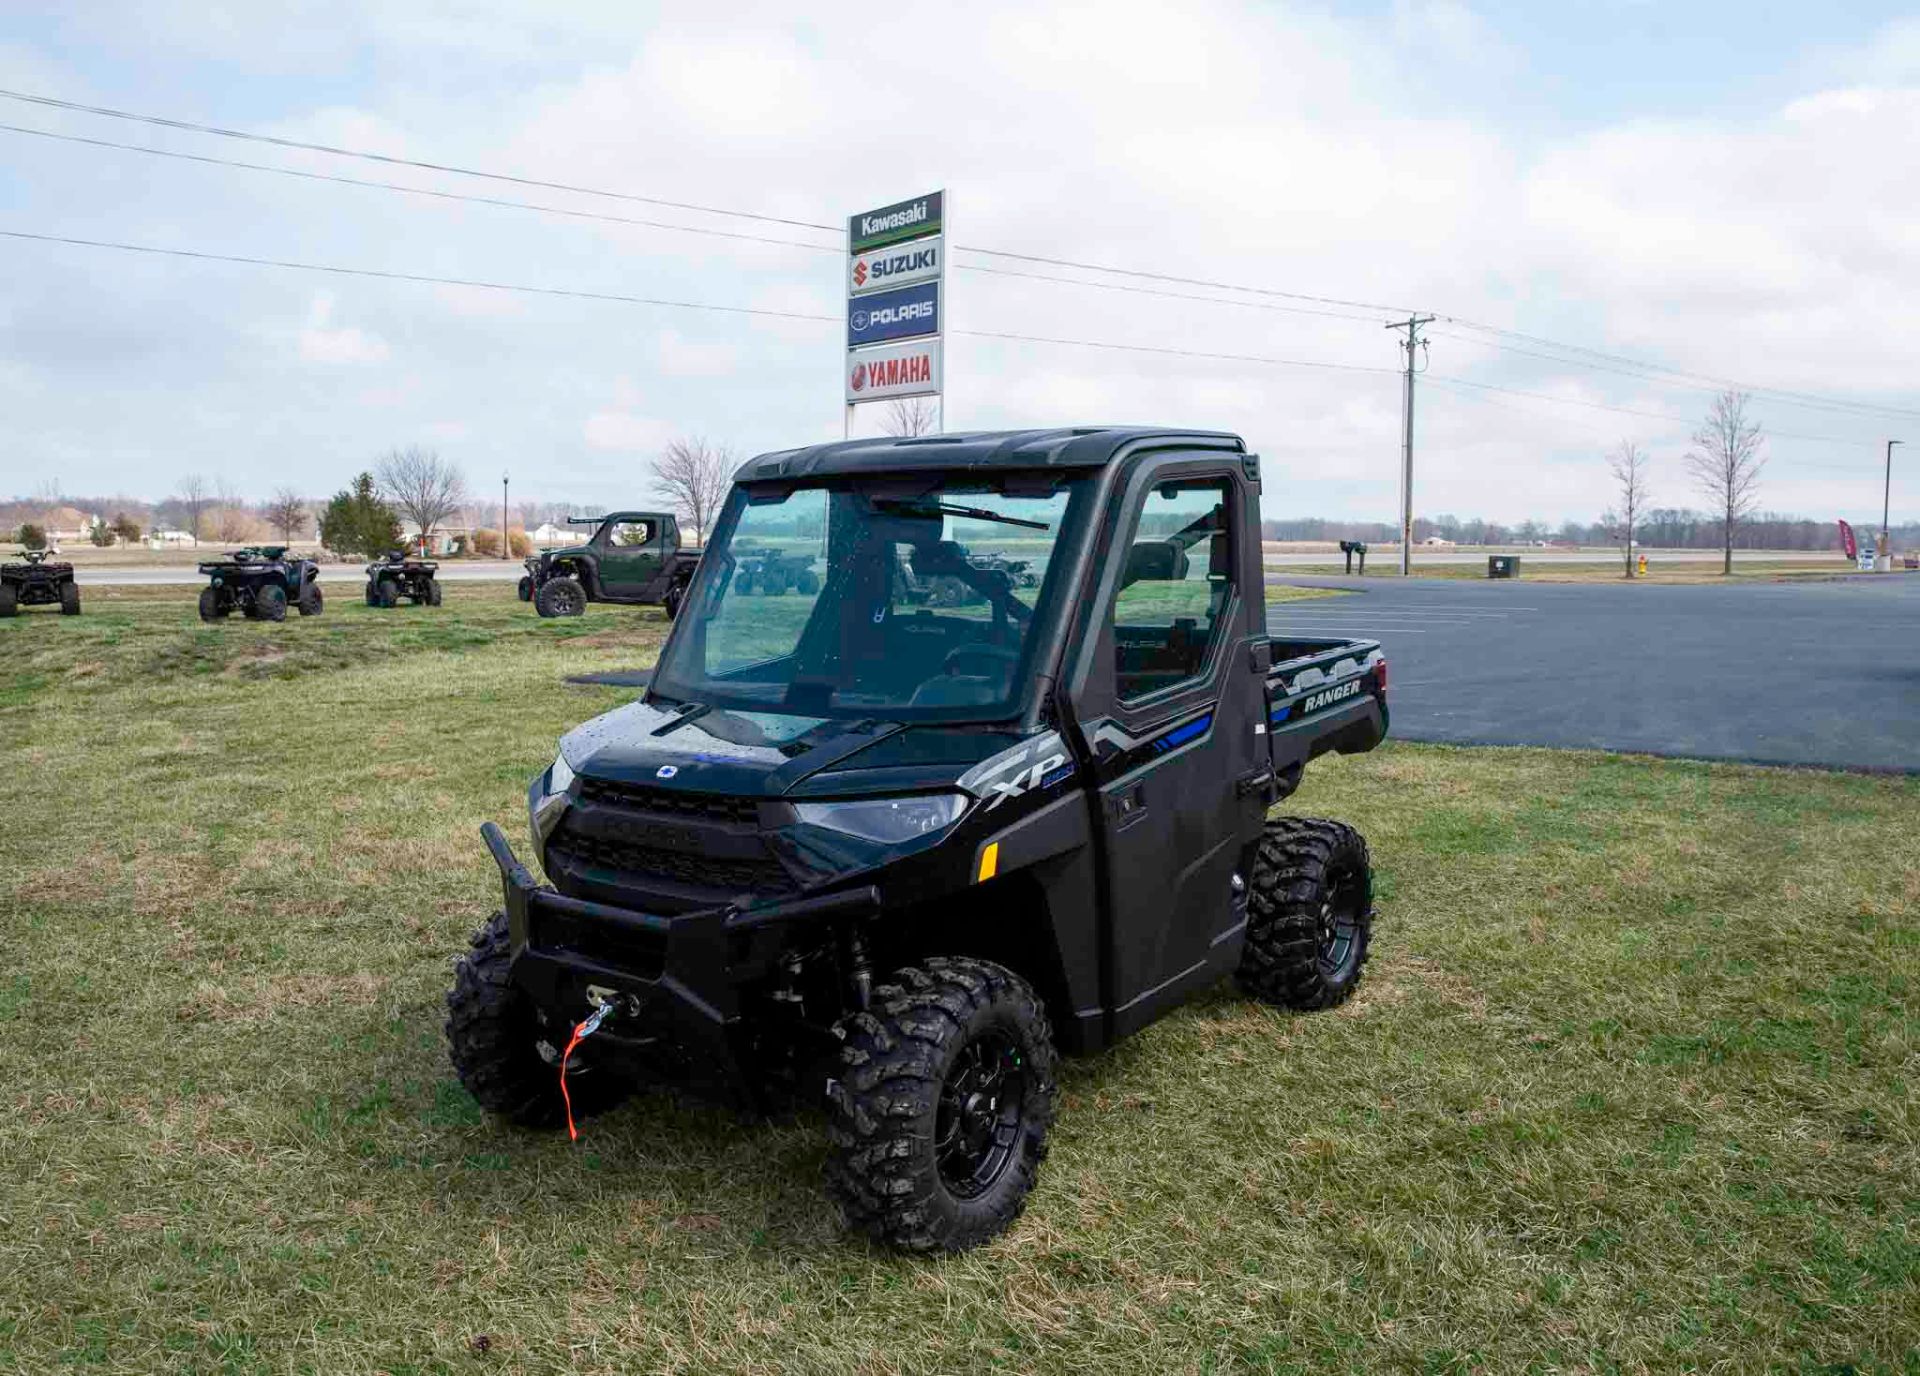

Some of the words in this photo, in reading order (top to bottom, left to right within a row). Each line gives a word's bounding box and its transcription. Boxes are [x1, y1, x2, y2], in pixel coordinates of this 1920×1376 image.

[862, 201, 927, 236] Kawasaki
[871, 248, 936, 279] SUZUKI
[870, 301, 933, 326] POLARIS
[868, 355, 931, 387] YAMAHA
[1304, 680, 1361, 712] RANGER
[984, 753, 1065, 813] XP
